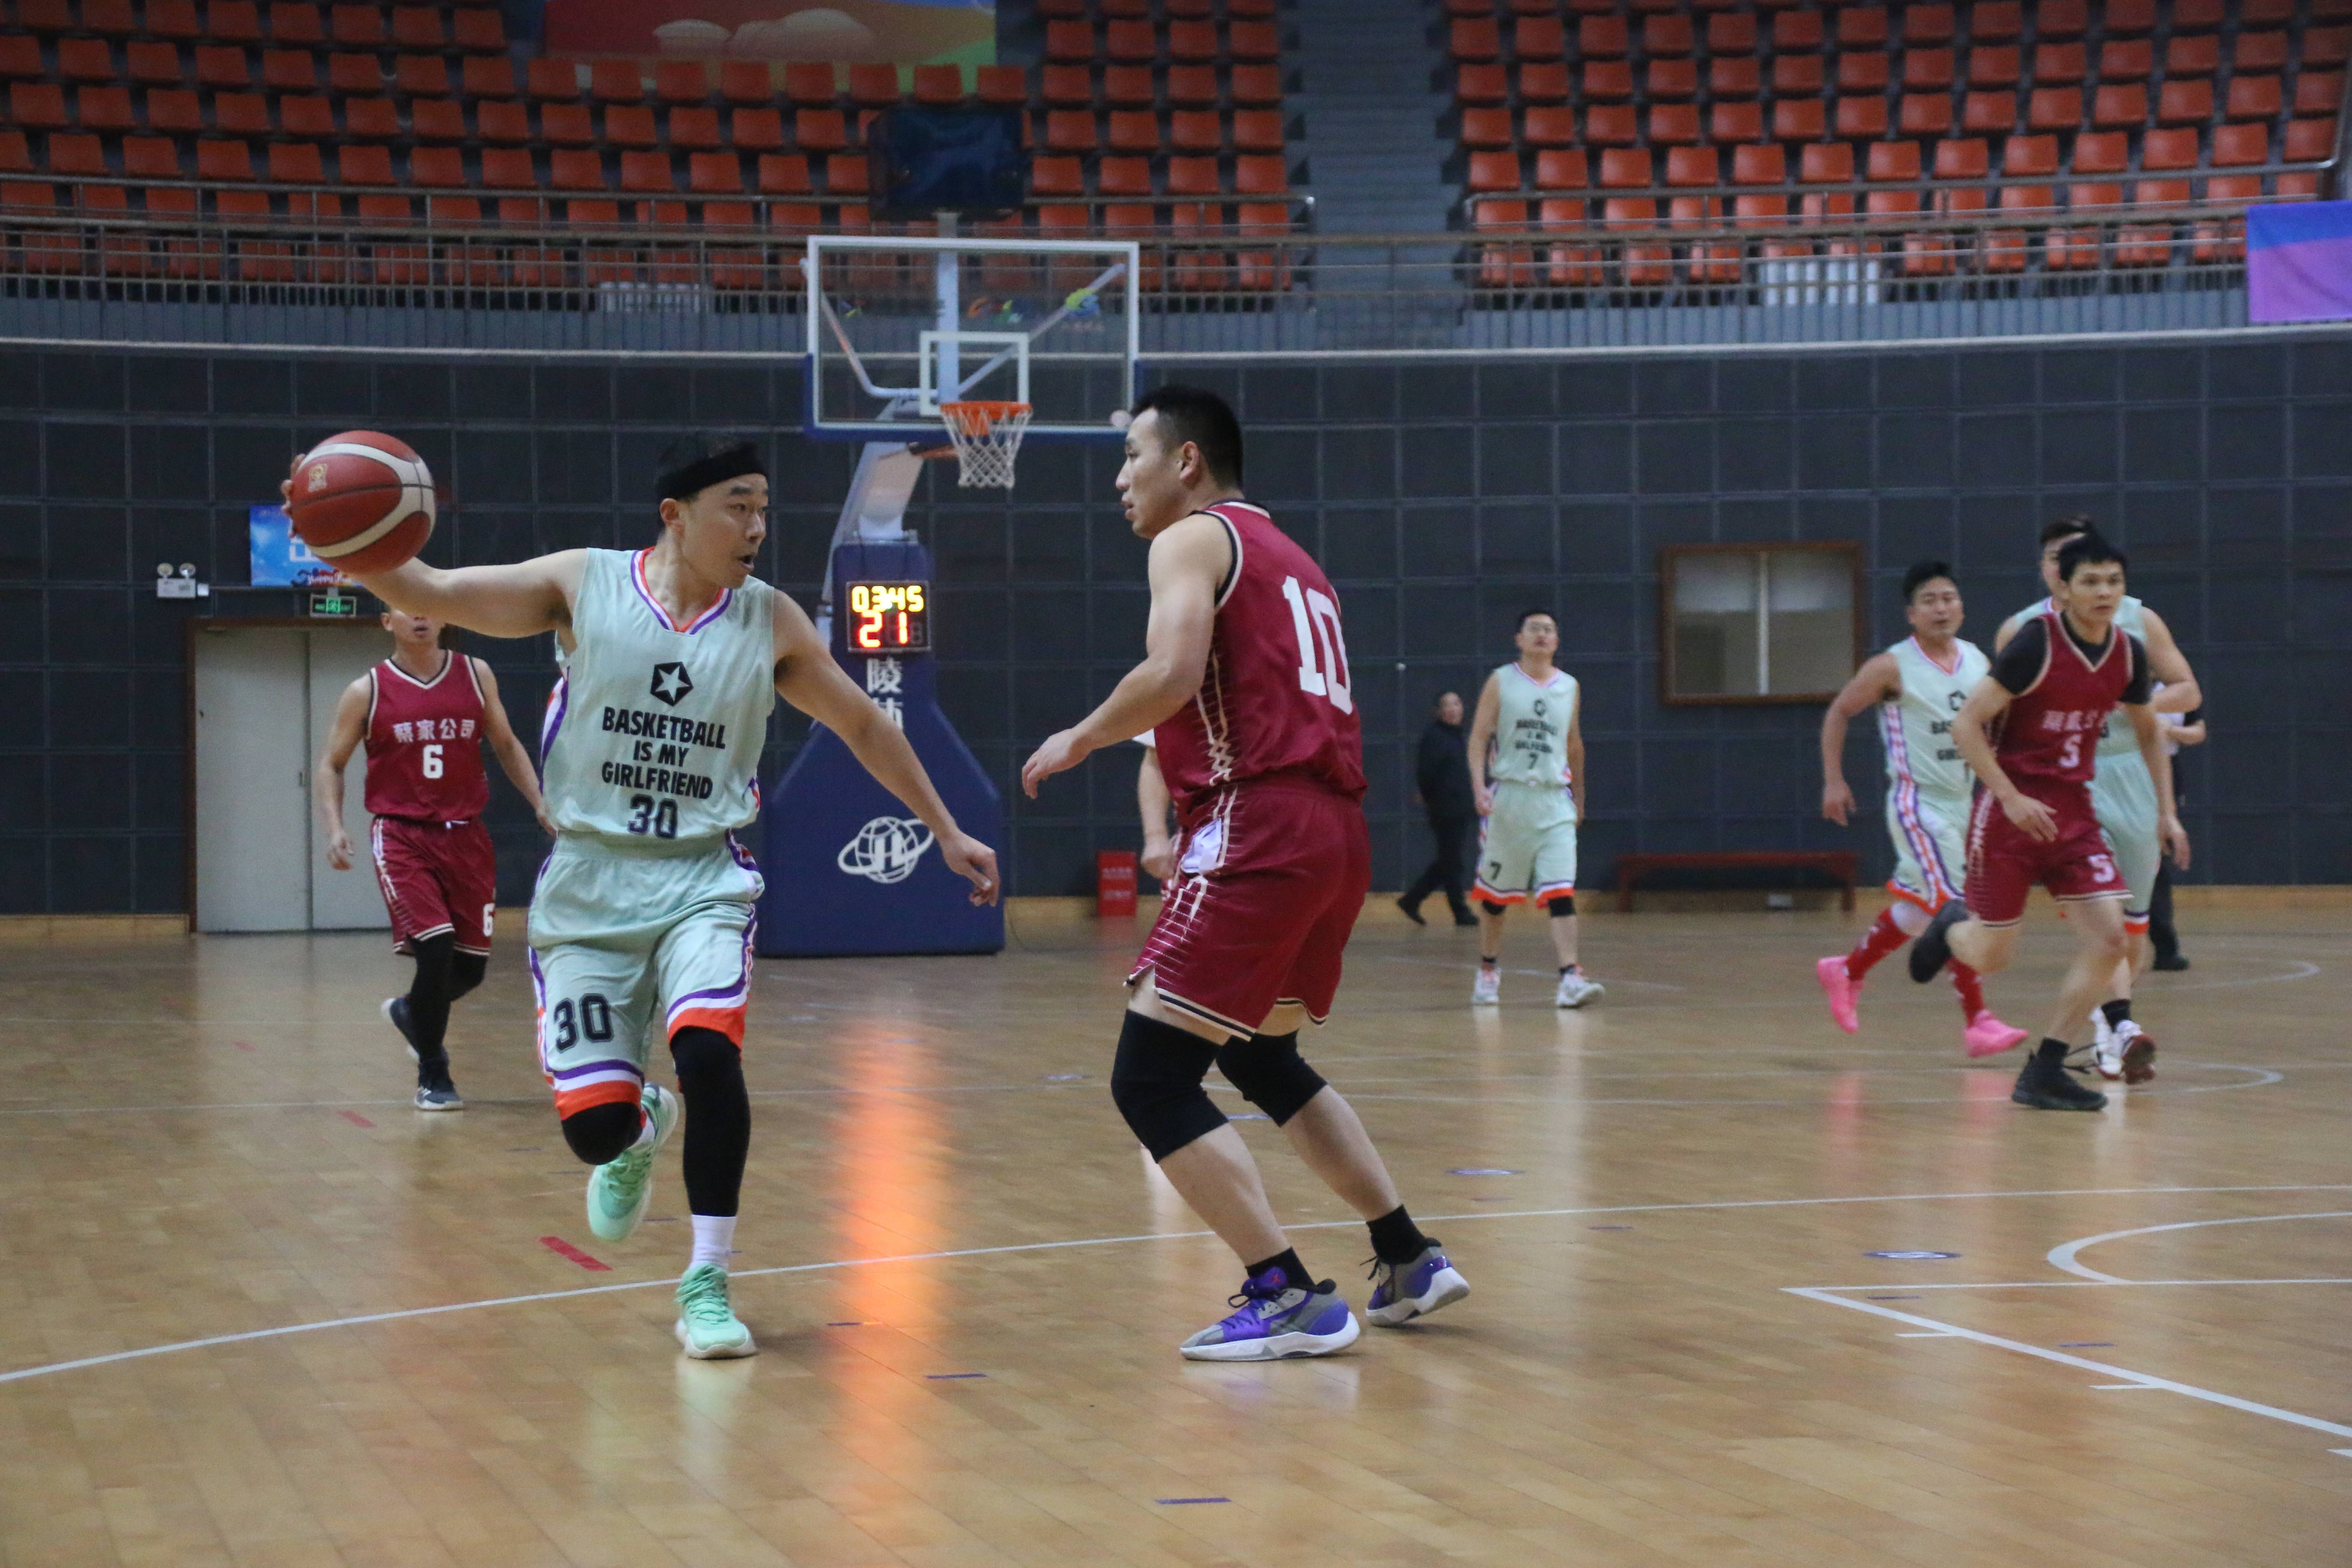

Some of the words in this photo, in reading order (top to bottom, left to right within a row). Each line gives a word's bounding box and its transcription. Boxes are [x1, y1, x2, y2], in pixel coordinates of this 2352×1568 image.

[860, 609, 908, 648] 21
[1282, 576, 1353, 715] 10
[602, 706, 726, 749] BASKETBALL
[423, 744, 444, 779] 6
[633, 740, 653, 761] IS
[658, 743, 689, 766] MY
[1528, 753, 1539, 770] 7
[2058, 734, 2082, 767] 5
[602, 761, 713, 799] GIRLFRIEND
[628, 794, 678, 839] 30
[1490, 861, 1502, 880] 7
[2088, 854, 2114, 883] 5
[483, 903, 495, 937] 6
[554, 993, 614, 1054] 30
